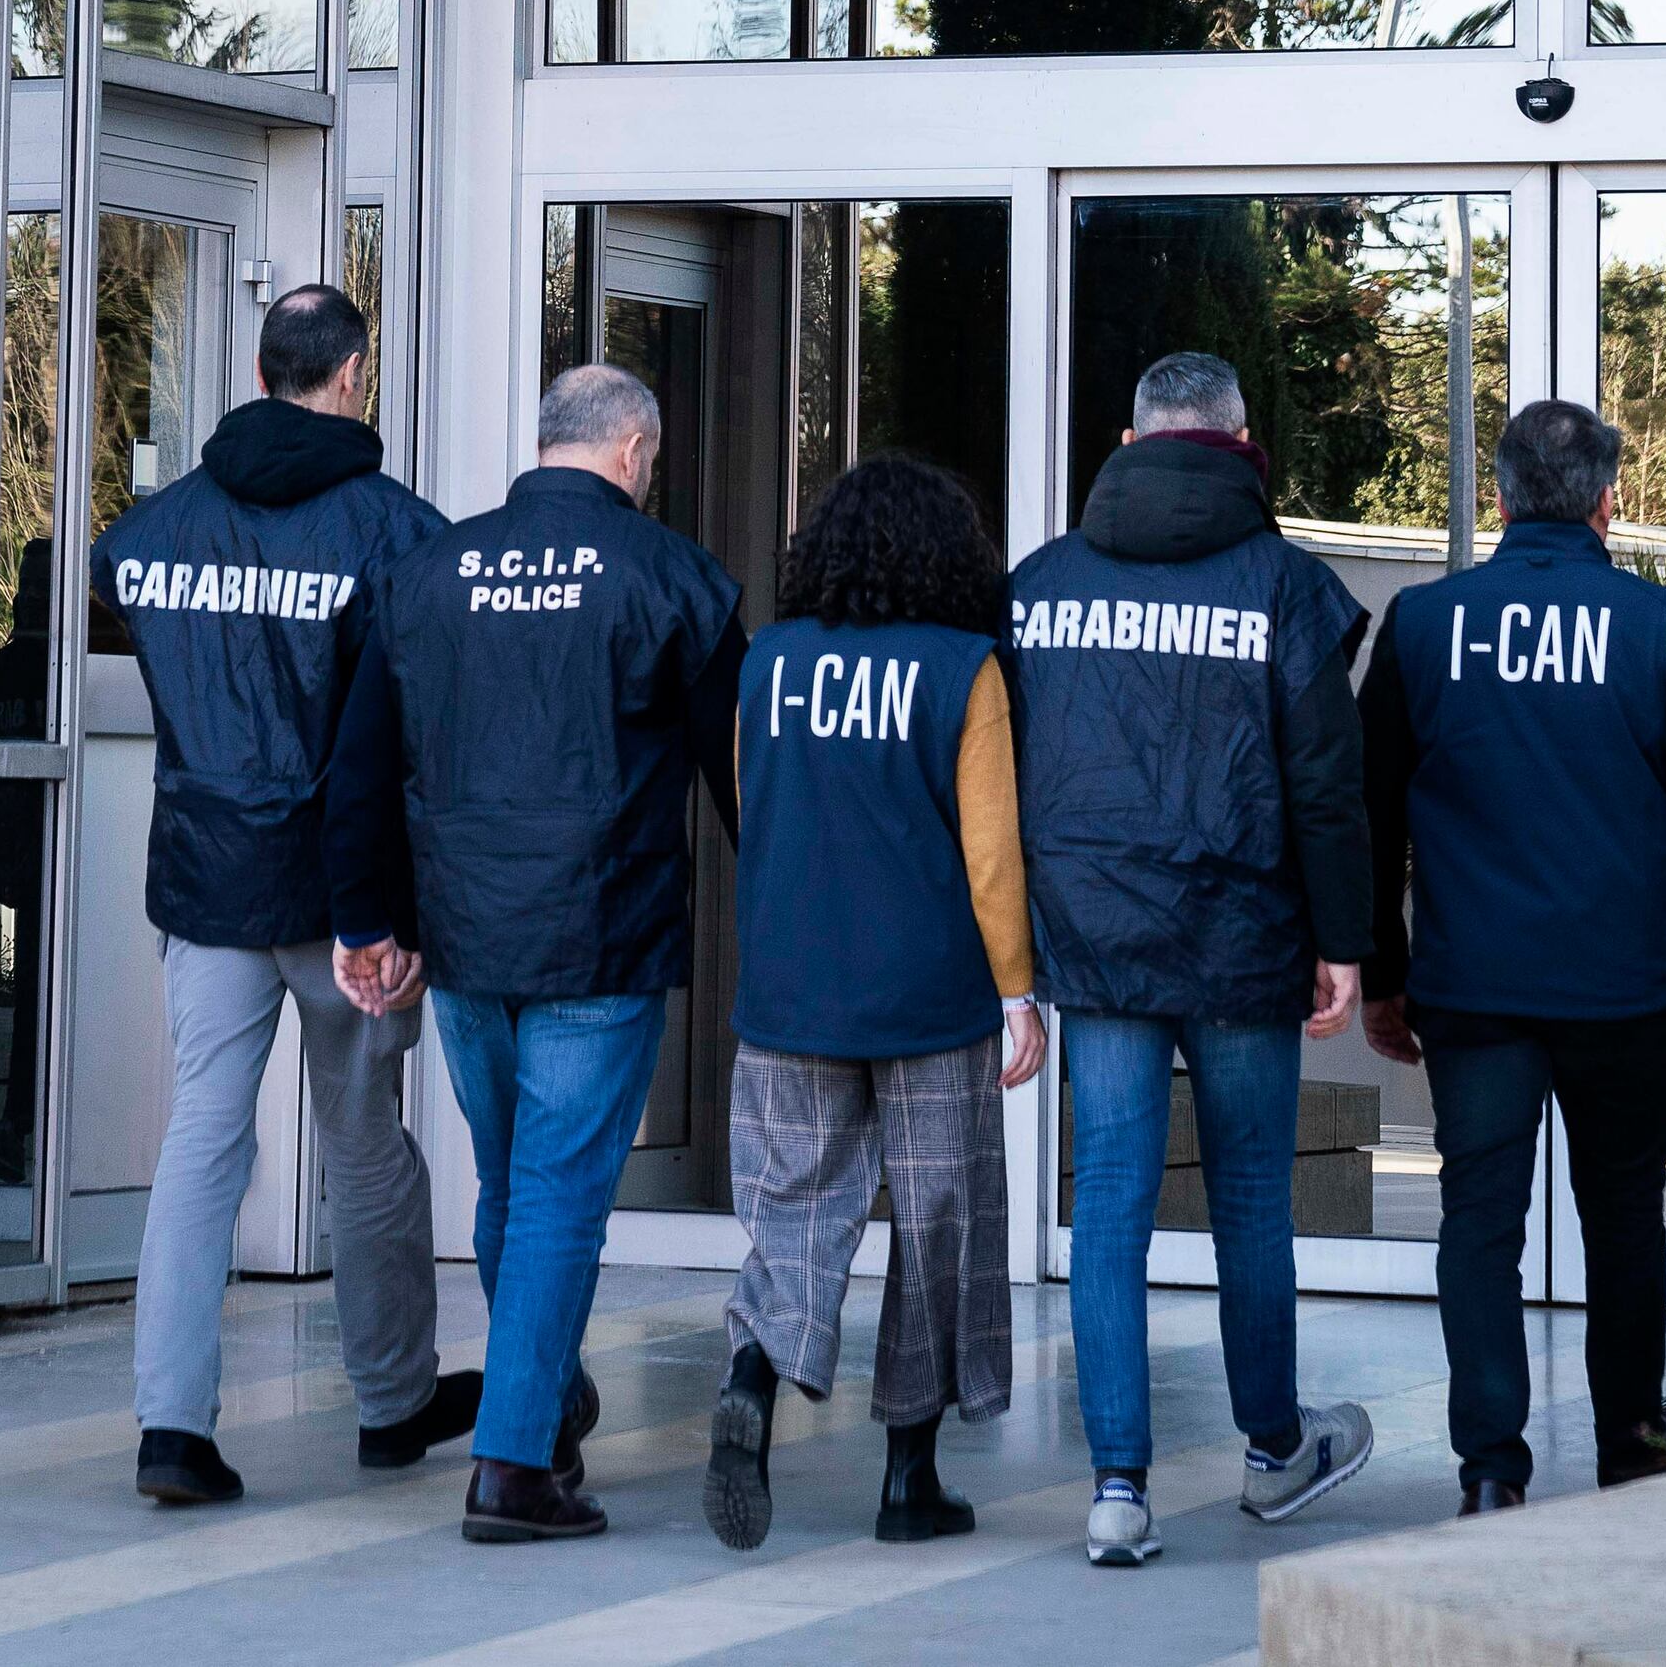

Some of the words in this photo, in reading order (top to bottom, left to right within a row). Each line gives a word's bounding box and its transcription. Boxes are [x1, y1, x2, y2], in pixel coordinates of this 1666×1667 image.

[458, 547, 604, 578] S.C.I.P.
[470, 583, 582, 612] POLICE
[1451, 603, 1611, 684] I-CAN
[770, 653, 920, 741] I-CAN
